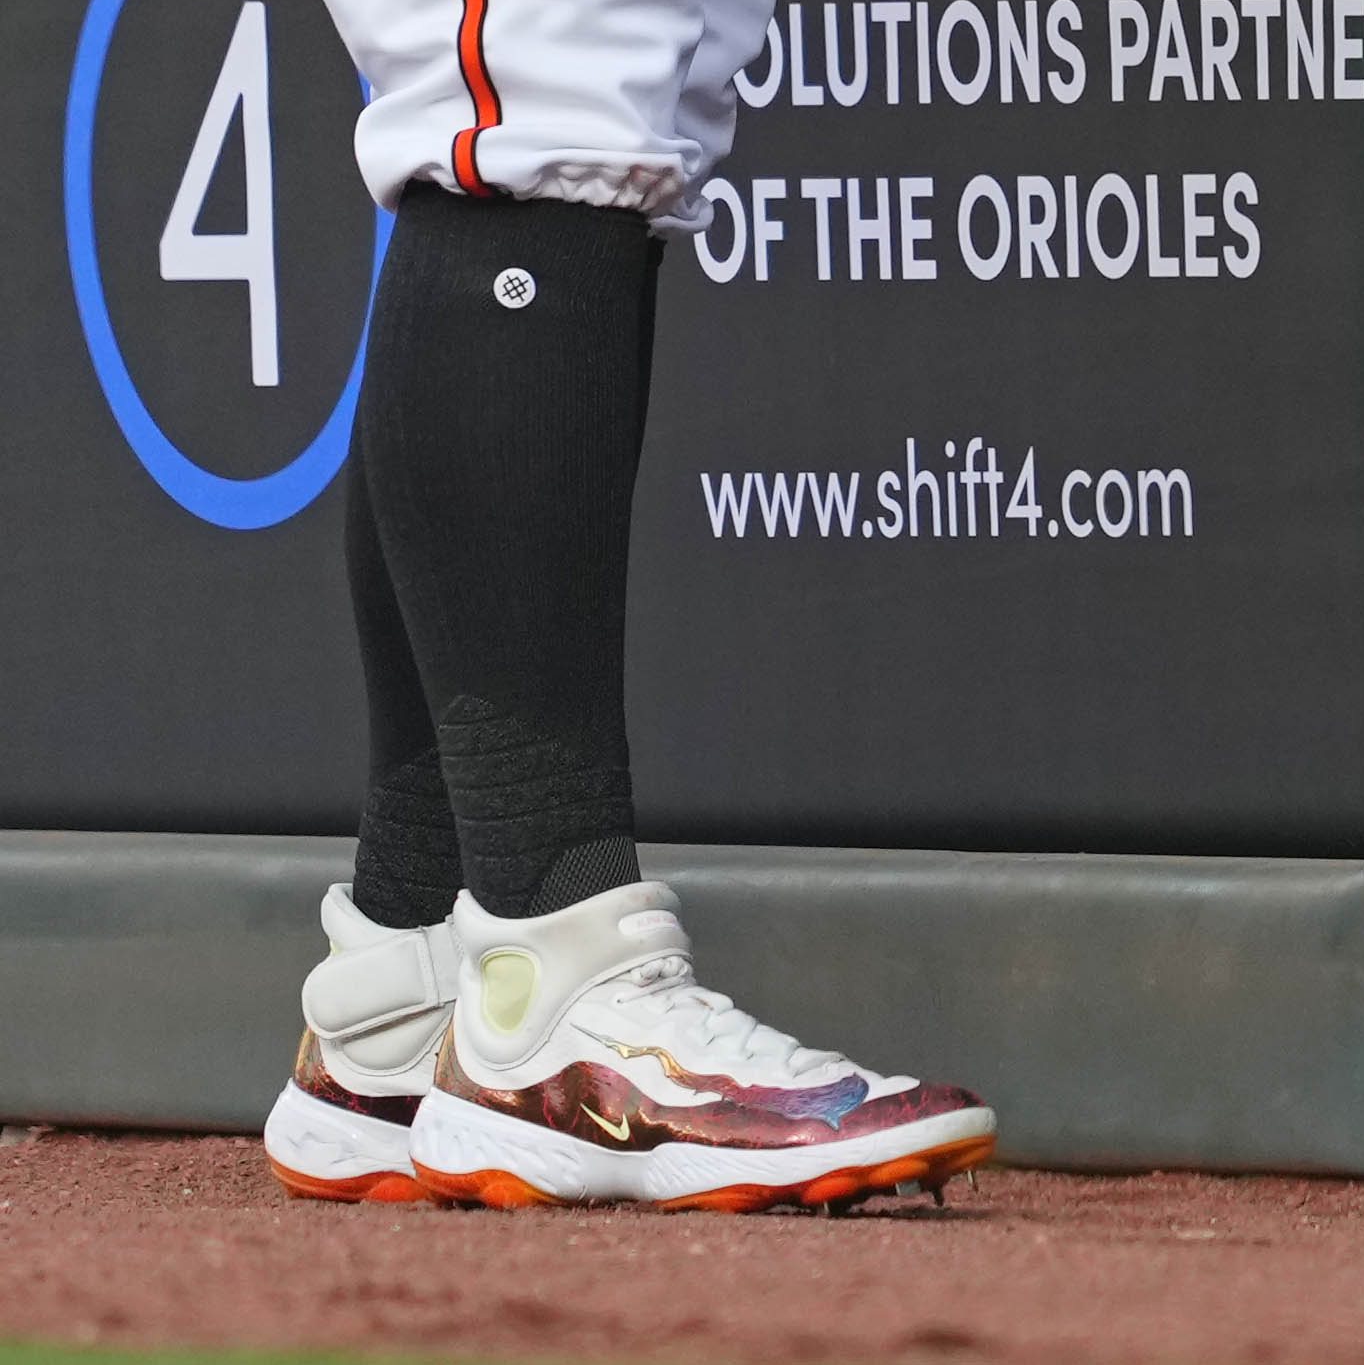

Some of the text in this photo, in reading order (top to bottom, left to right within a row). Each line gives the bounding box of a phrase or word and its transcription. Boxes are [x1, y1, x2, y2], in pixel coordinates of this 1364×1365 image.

[159, 1, 279, 387] 4
[694, 172, 1262, 283] OF THE ORIOLES
[700, 436, 1194, 539] www.shift4.com
